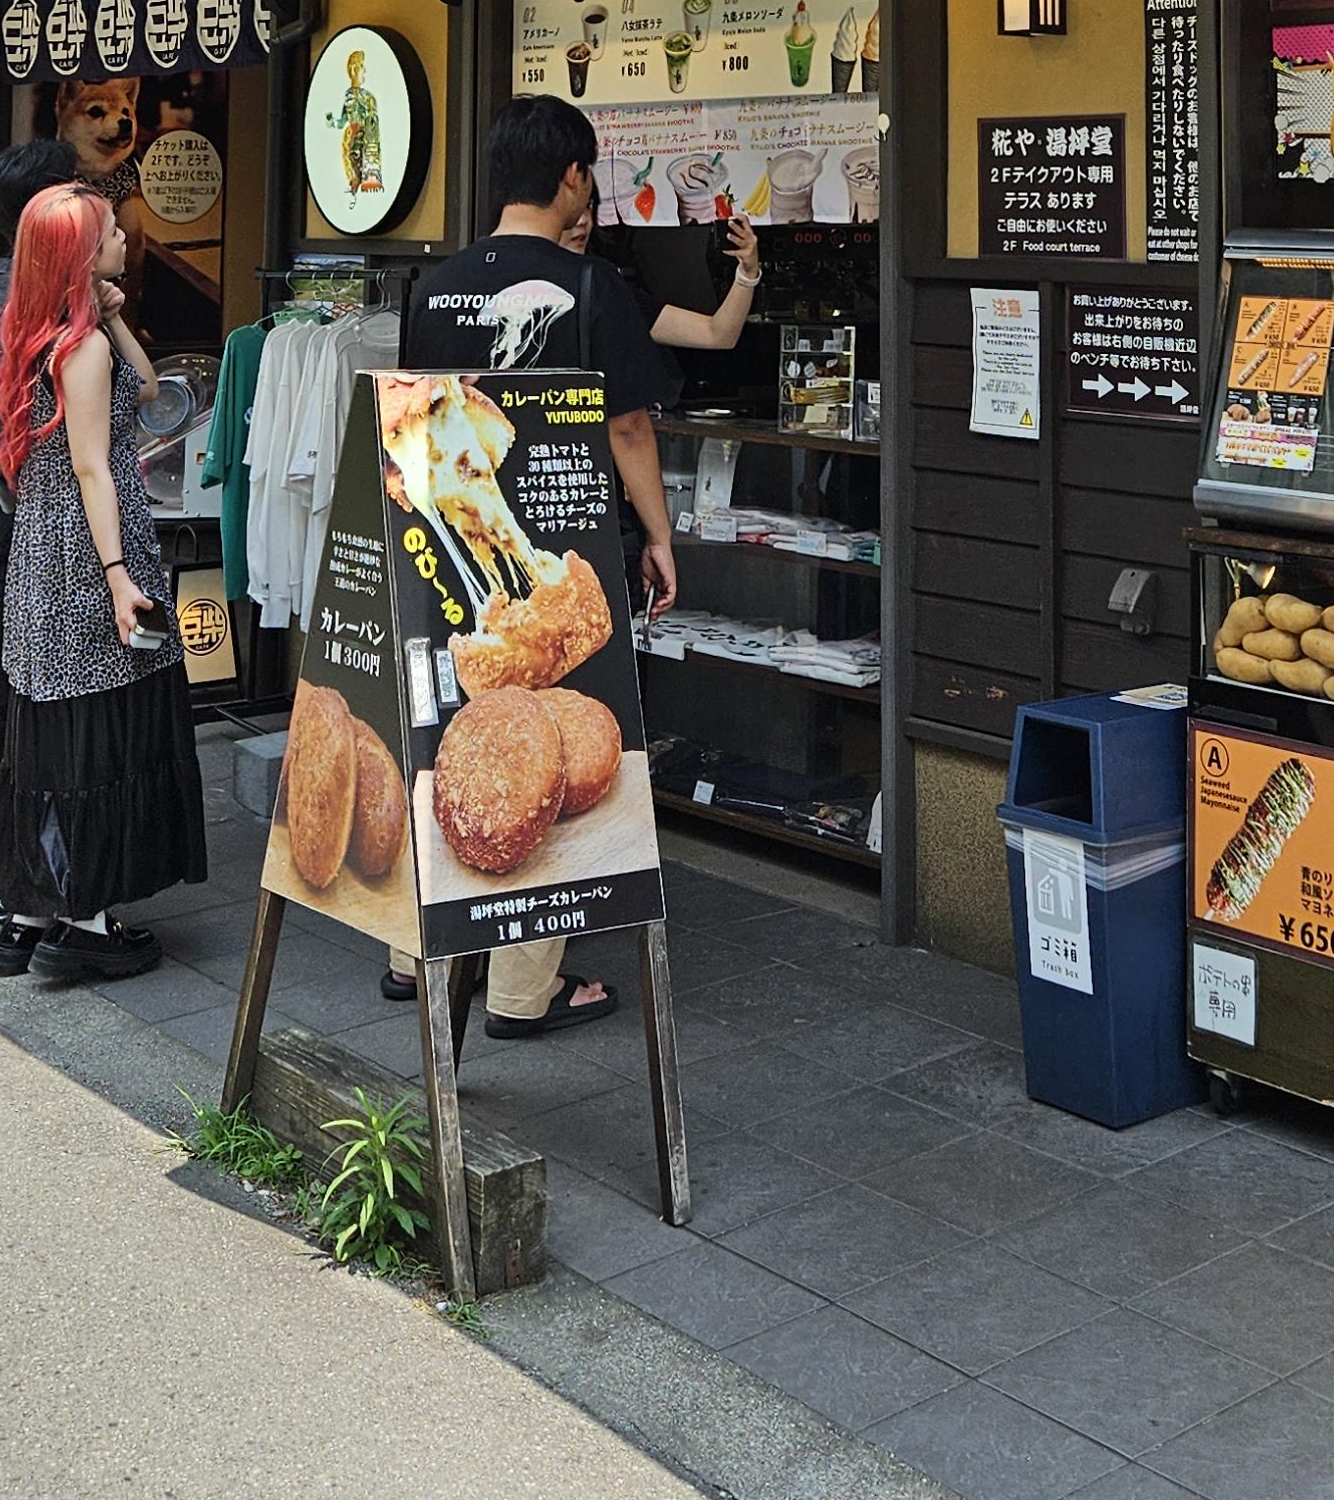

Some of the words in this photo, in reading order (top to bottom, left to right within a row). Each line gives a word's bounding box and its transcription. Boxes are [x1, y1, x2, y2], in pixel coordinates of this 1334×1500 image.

[523, 7, 536, 24] 02
[722, 6, 785, 24] 九条メロンソーダ
[522, 26, 560, 40] アメリカーノ
[621, 62, 646, 77] ¥650
[722, 55, 749, 71] ¥800
[522, 68, 545, 83] ¥550
[990, 165, 1114, 184] 2Fテイクアウト専用
[1004, 192, 1042, 210] テラス
[1046, 191, 1097, 209] あります
[997, 218, 1107, 234] ご自由にお使いください
[1002, 240, 1017, 252] 2F
[1022, 240, 1044, 252] Food
[1045, 242, 1068, 253] court
[1069, 242, 1101, 253] terrace
[456, 315, 500, 326] PARIS
[1084, 313, 1184, 332] 出来上がりをお待ちの
[1072, 331, 1198, 354] お客様は右側の自販機近辺
[500, 387, 605, 408] カレーパン専門店
[544, 410, 605, 425] YUTUBODO
[527, 442, 590, 459] 完熟トマトと
[516, 471, 609, 489] スパイスを使用した
[517, 487, 609, 504] コクのあるカレーと
[524, 501, 607, 520] とろけるチーズの
[536, 517, 599, 534] マリアージュ
[319, 606, 387, 647] カレーパン
[1200, 775, 1230, 791] Seaweed
[1200, 785, 1248, 805] Japanesesauce
[1200, 796, 1240, 814] Mayonnaise
[1300, 866, 1334, 887] 青のり
[469, 885, 613, 922] 湯坪堂特製チーズカレーパン
[533, 909, 586, 934] 400円
[1040, 935, 1078, 964] ゴミ箱
[1041, 959, 1062, 974] Trash
